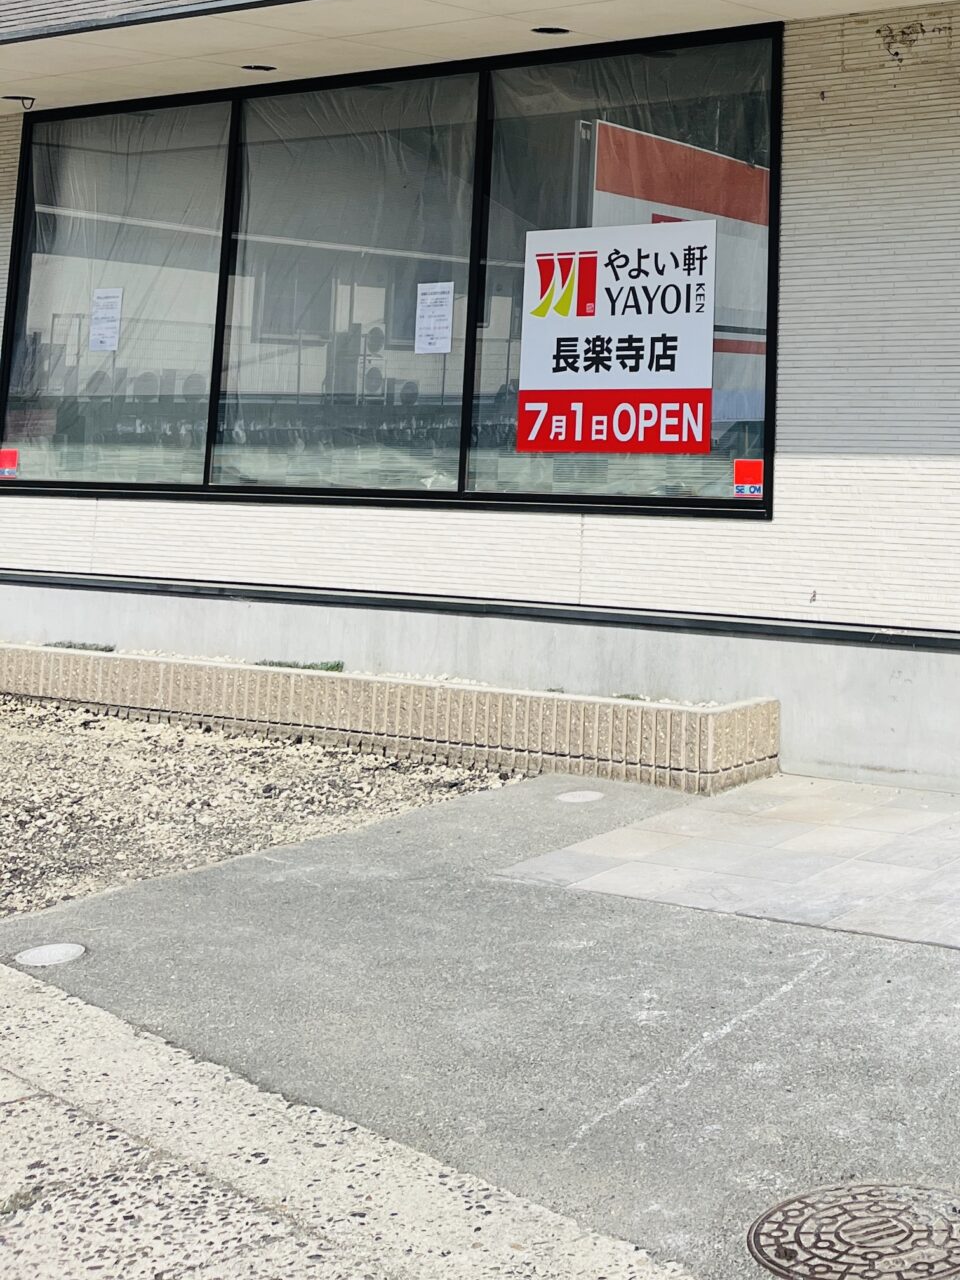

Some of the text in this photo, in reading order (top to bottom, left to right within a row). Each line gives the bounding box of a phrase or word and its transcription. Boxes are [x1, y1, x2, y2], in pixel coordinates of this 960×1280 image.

[604, 245, 708, 282] やよい軒
[604, 282, 705, 316] YAYOI KEN
[552, 333, 678, 373] 長楽寺店
